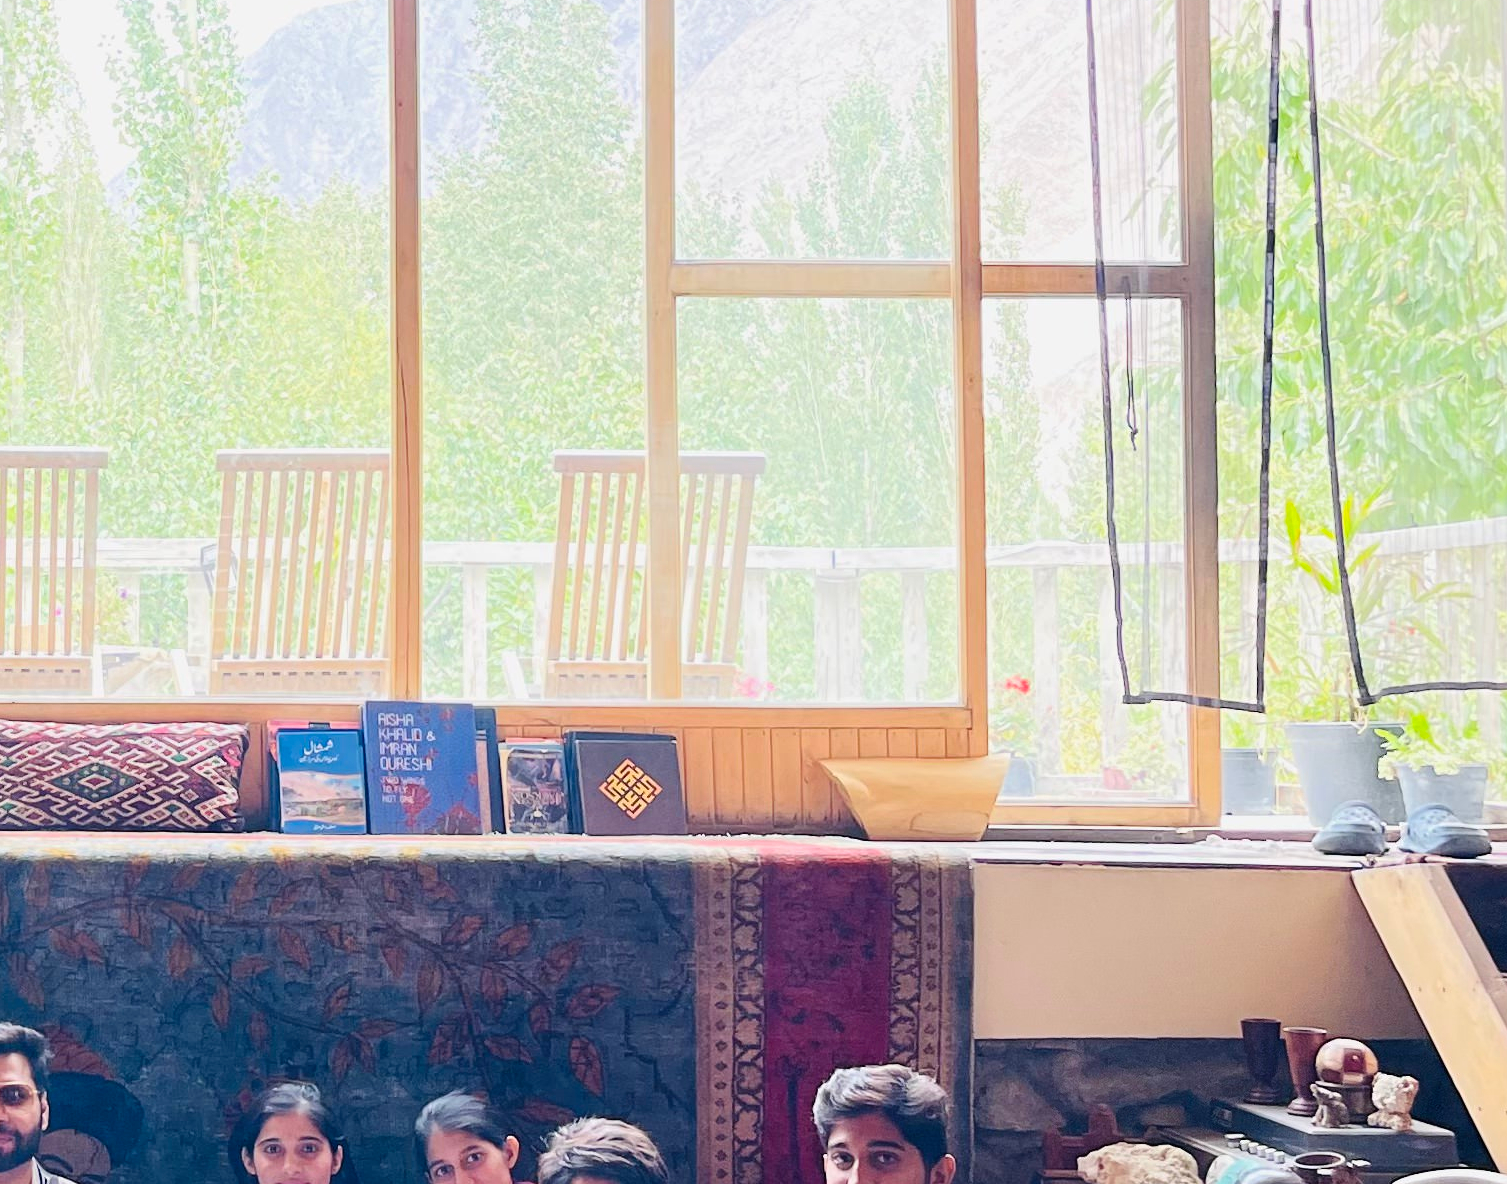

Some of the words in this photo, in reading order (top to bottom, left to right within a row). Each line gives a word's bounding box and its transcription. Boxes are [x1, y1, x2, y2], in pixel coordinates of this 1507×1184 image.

[378, 713, 414, 726] AISHA
[379, 728, 422, 741] KHALID
[426, 730, 436, 741] &
[379, 742, 417, 755] IMRAN
[379, 757, 433, 771] QURESHI
